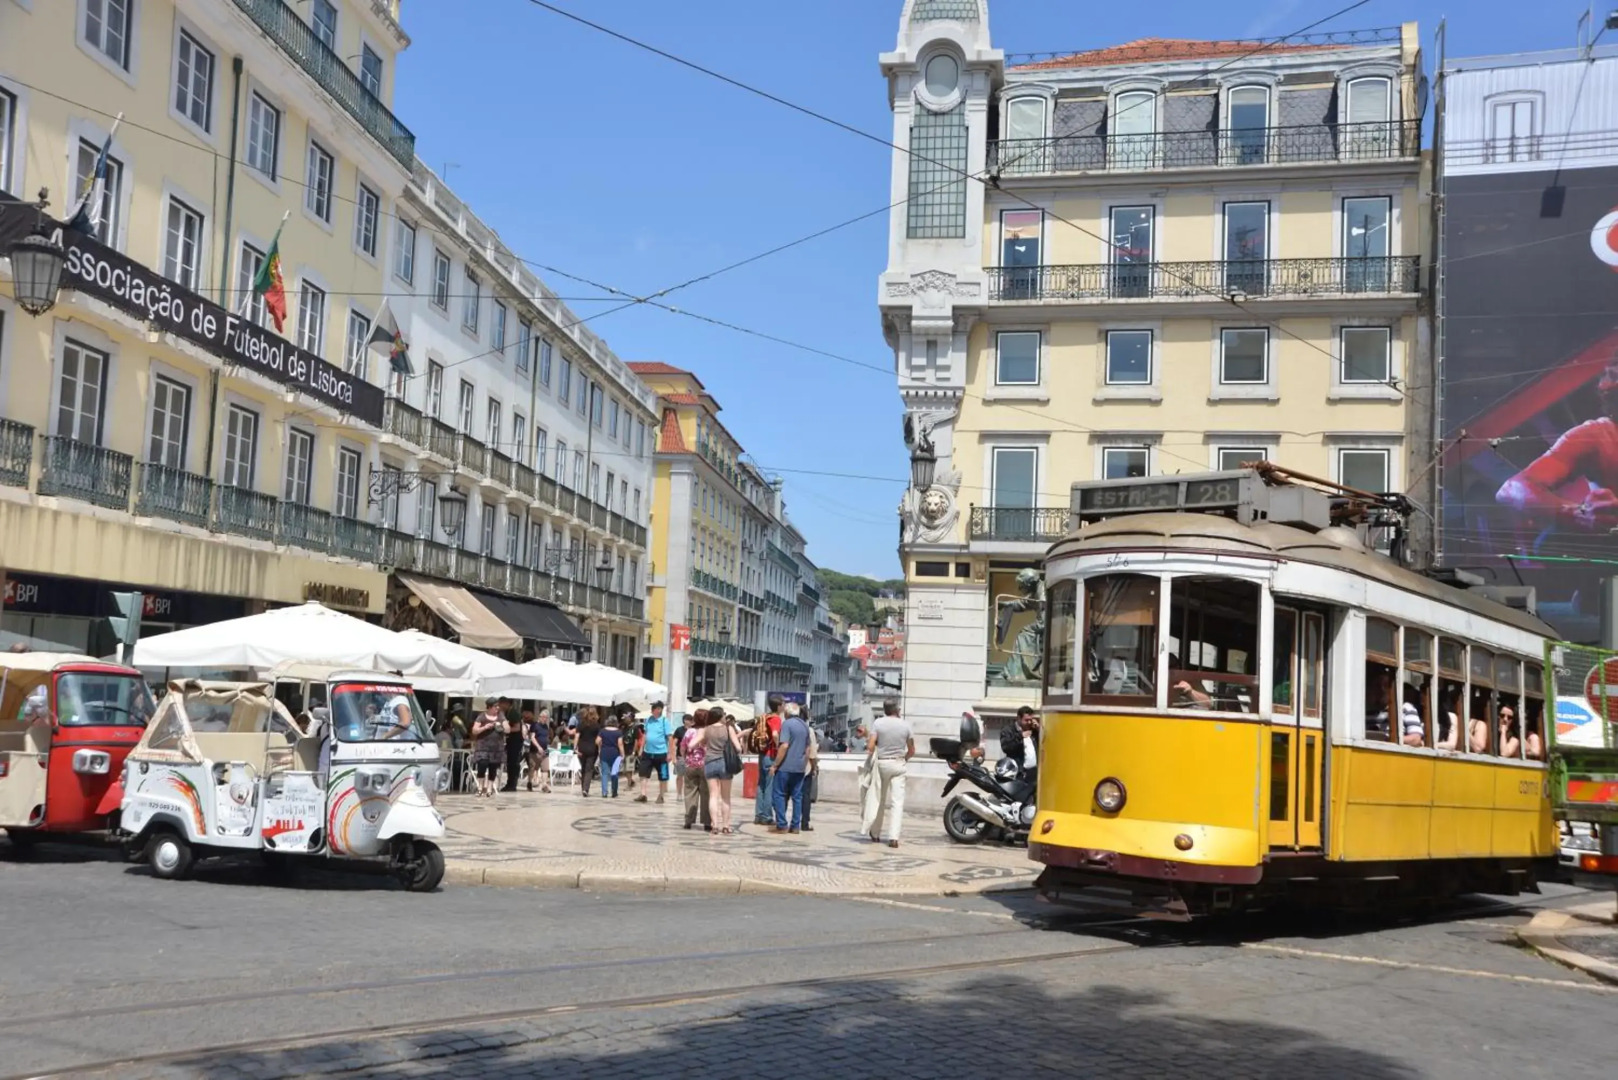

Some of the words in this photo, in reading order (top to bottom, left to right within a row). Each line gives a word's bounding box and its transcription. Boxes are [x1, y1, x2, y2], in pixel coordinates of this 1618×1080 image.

[50, 227, 184, 323] Associação
[190, 303, 217, 339] de
[224, 315, 284, 372] Futebol
[288, 351, 307, 382] de
[310, 360, 353, 404] Lisboa
[1200, 483, 1231, 503] 28
[16, 584, 39, 603] BPI
[154, 598, 171, 614] BPI
